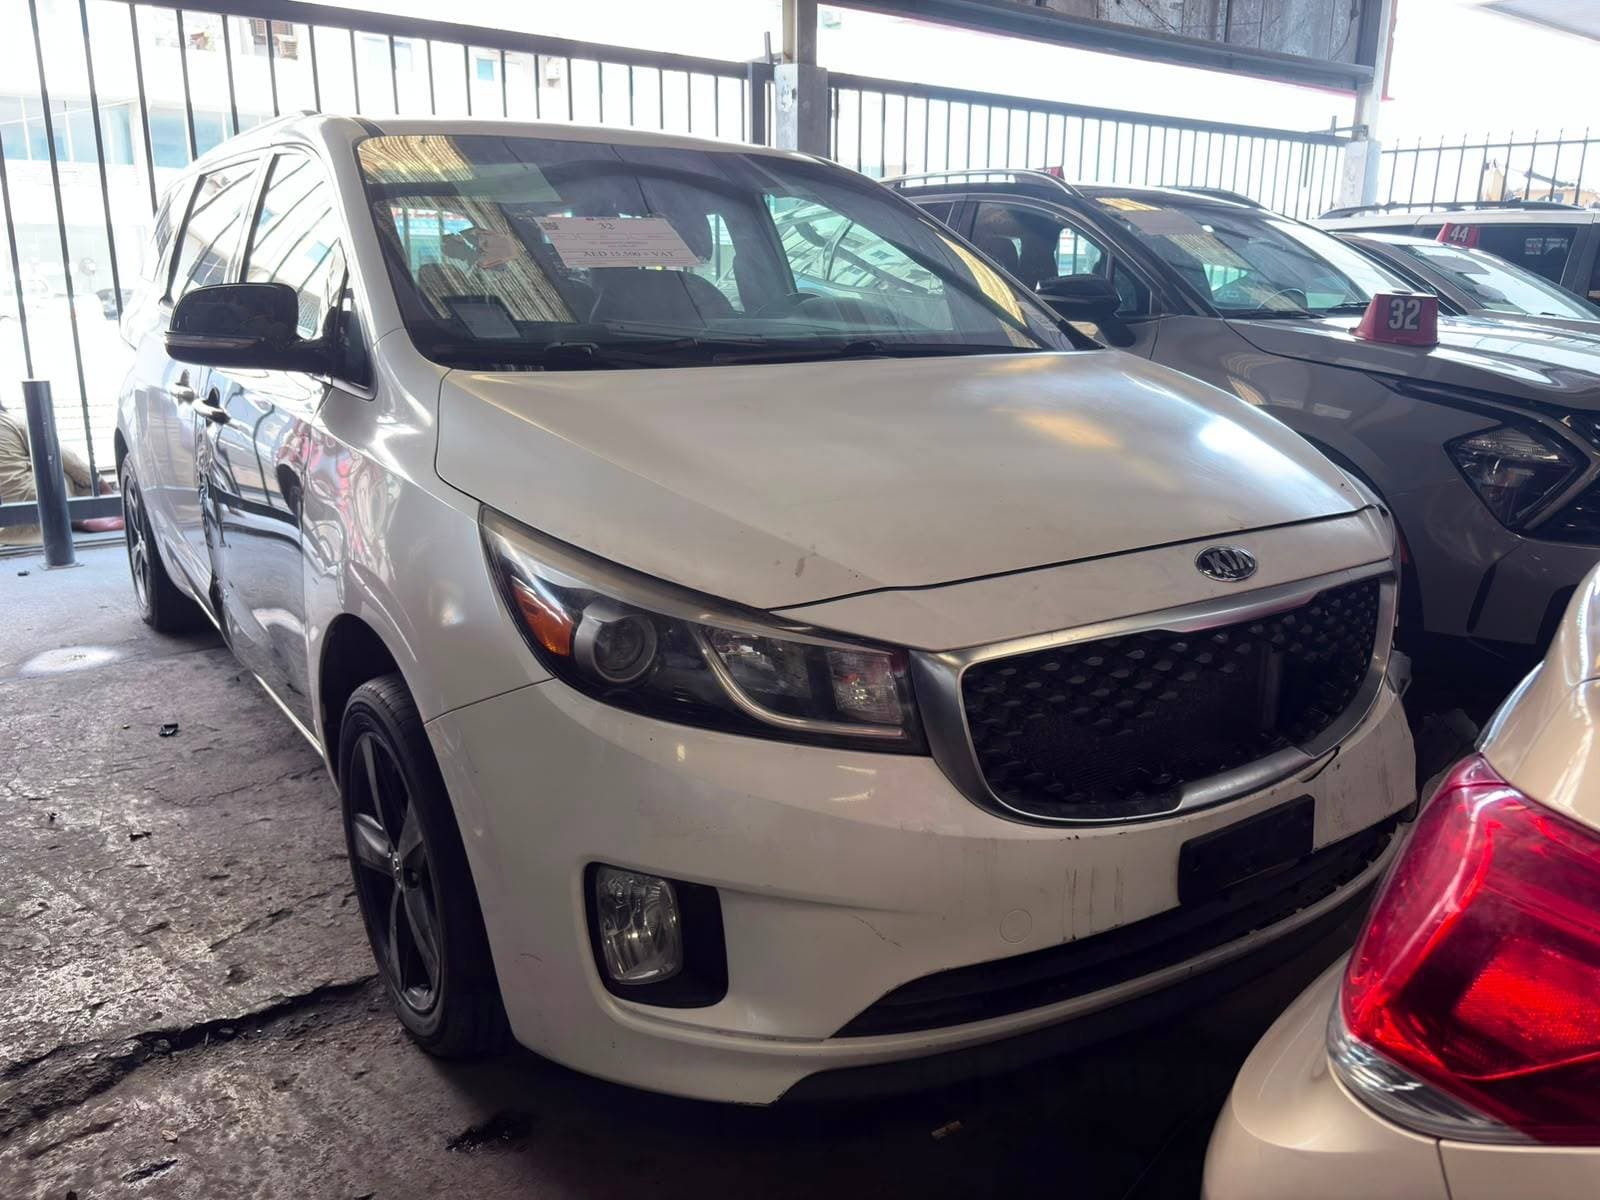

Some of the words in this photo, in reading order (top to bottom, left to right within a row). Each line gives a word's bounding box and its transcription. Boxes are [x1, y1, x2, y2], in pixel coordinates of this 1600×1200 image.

[1450, 225, 1469, 242] 44
[1388, 298, 1420, 330] 32
[1202, 548, 1255, 576] KIA
